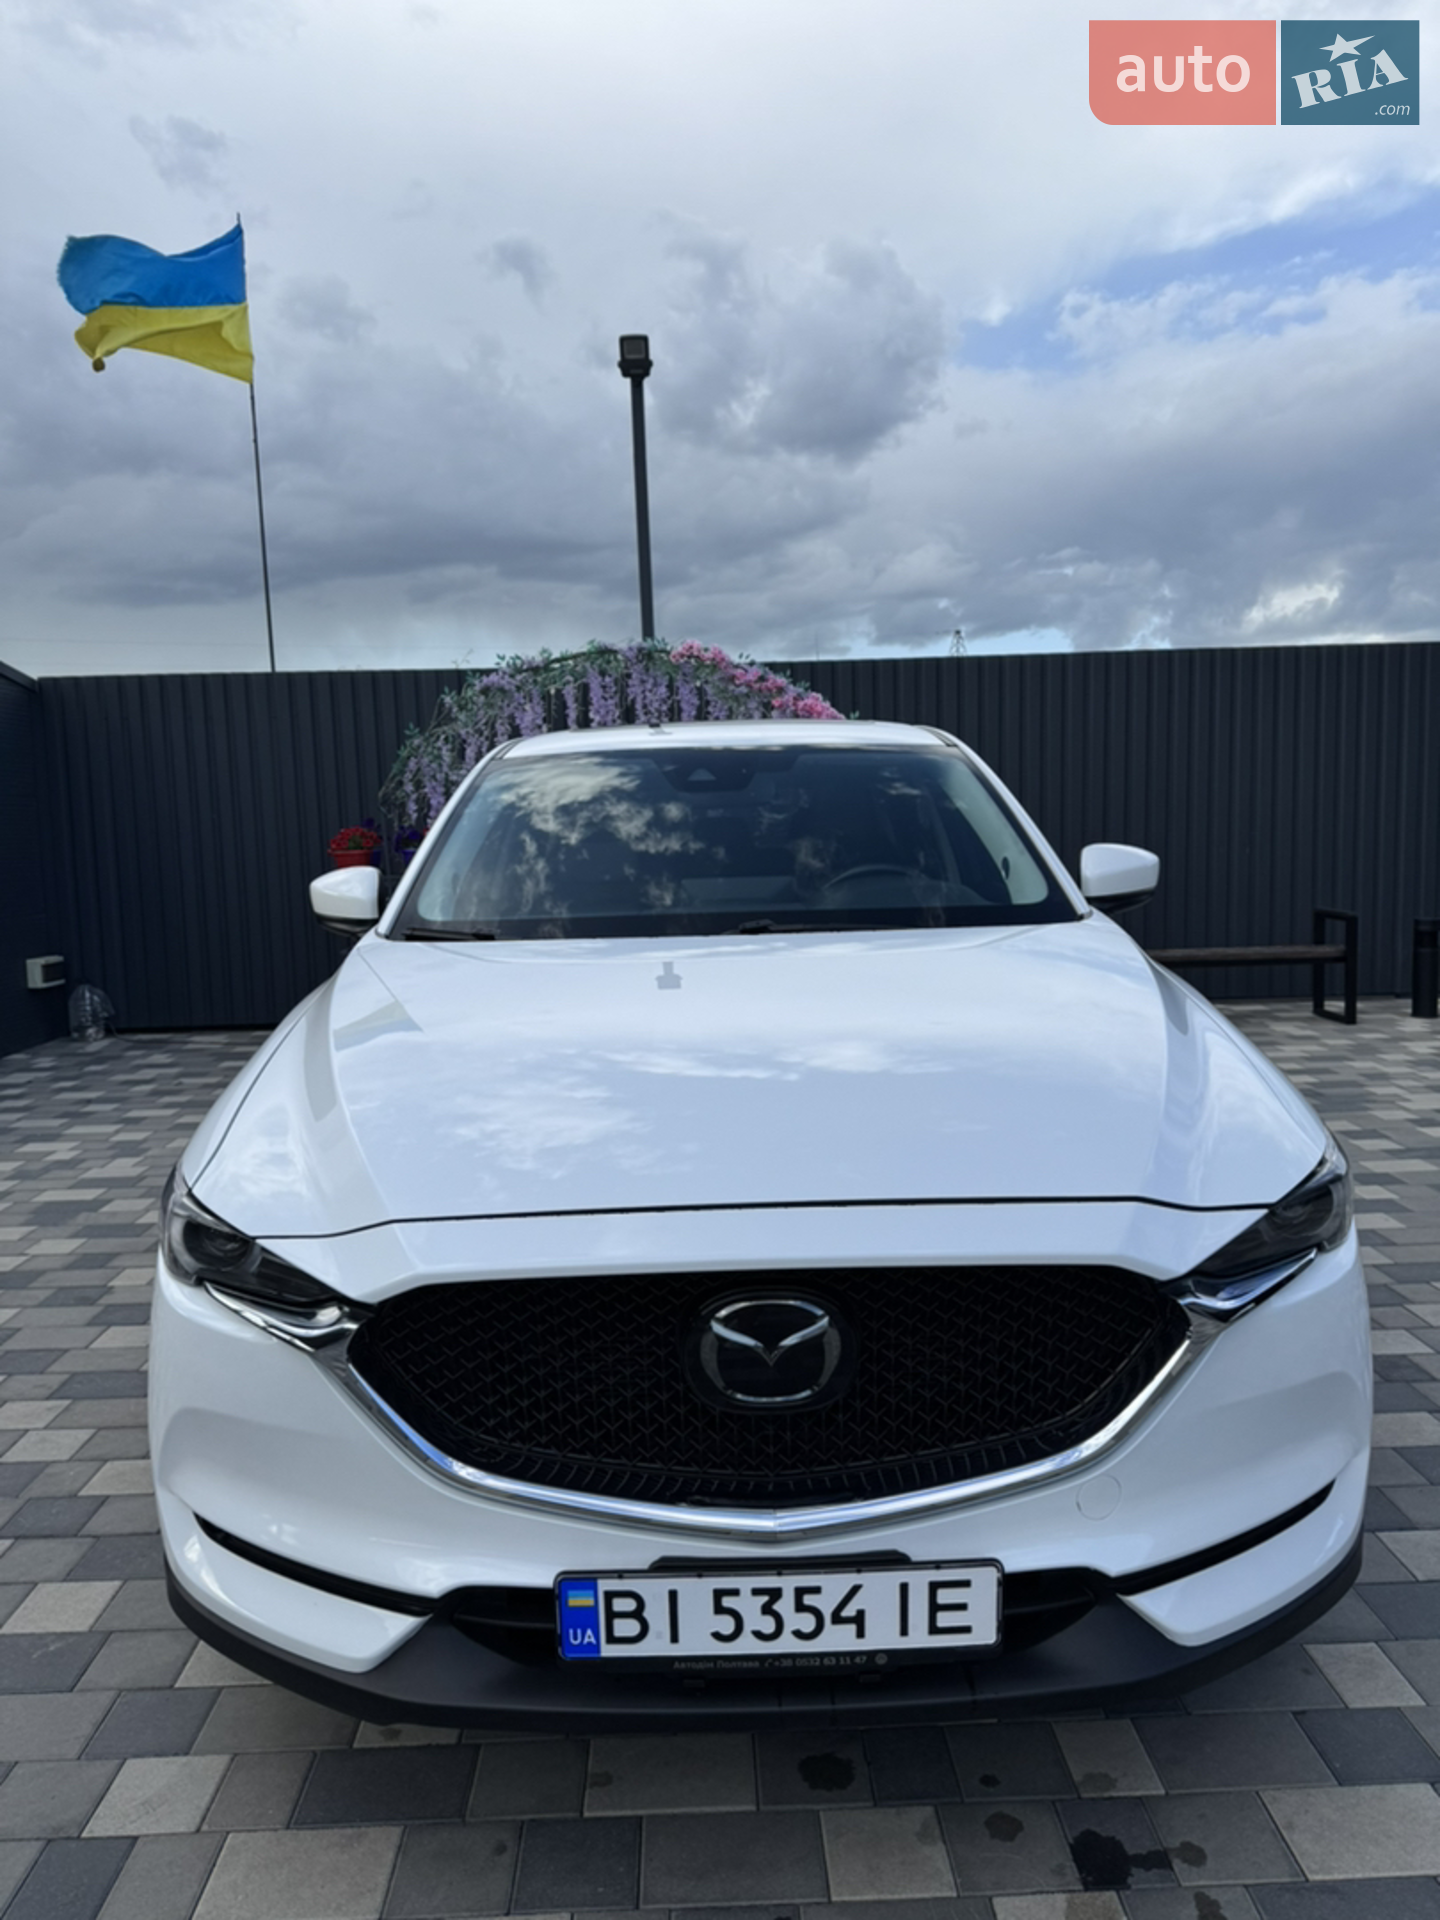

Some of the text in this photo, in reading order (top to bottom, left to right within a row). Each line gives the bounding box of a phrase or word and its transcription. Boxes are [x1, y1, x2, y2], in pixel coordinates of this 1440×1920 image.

[602, 1579, 973, 1645] BI 5354 IE
[568, 1628, 597, 1646] UA
[838, 1656, 851, 1665] 11
[853, 1655, 867, 1664] 47
